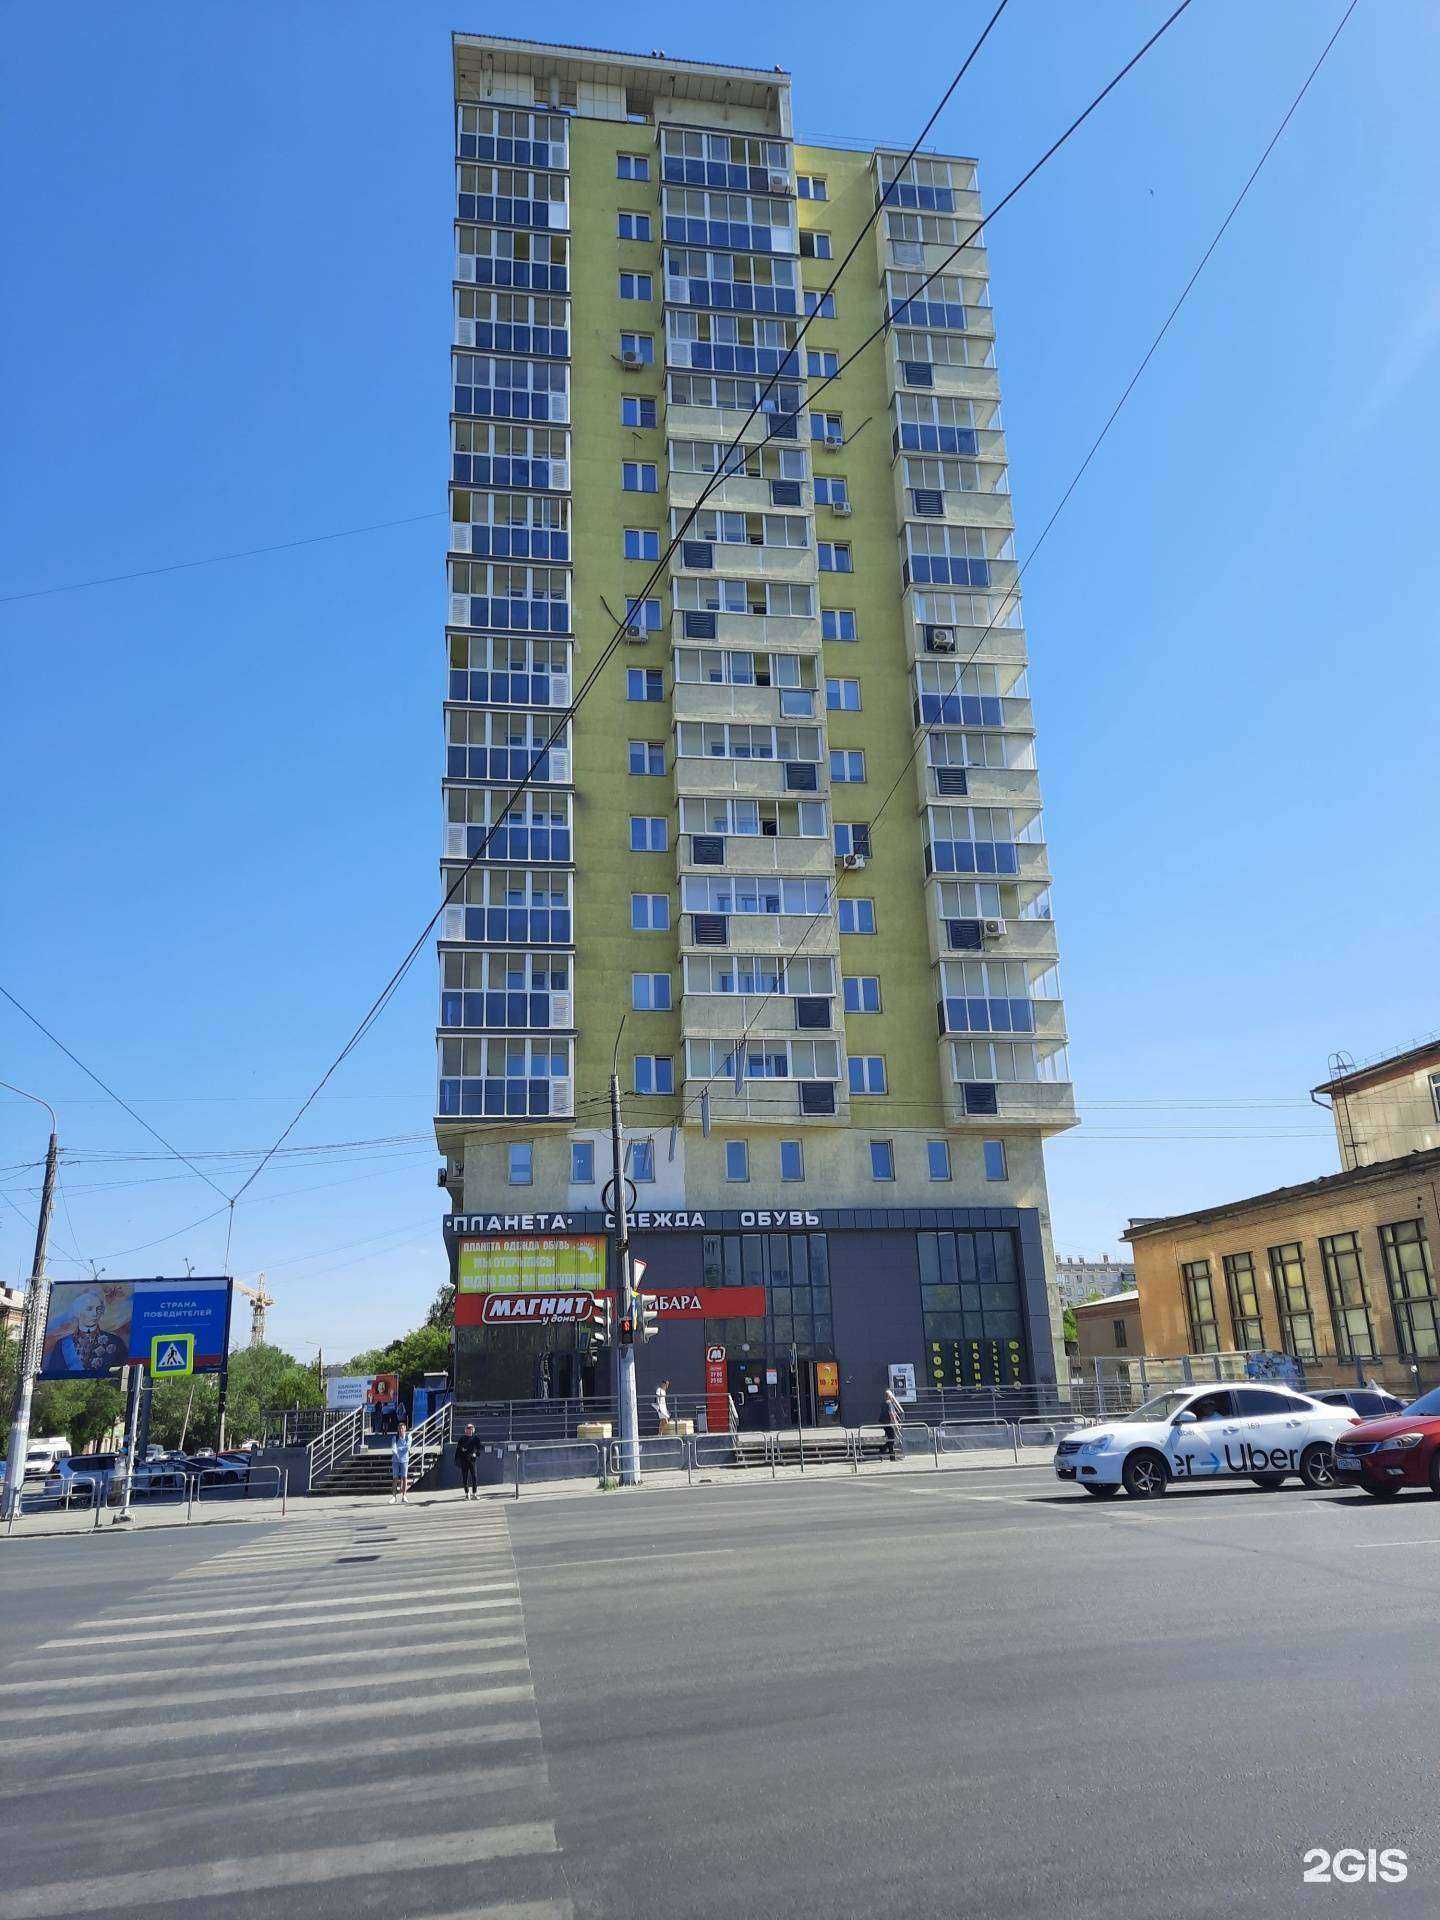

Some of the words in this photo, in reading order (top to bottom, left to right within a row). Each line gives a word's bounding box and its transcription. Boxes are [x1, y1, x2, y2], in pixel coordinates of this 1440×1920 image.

[453, 1214, 567, 1232] ПЛАНЕТА
[740, 1211, 820, 1227] ОБУВЬ
[463, 1241, 501, 1252] ПЛАНЕТА
[503, 1240, 540, 1251] ОДЕЖДА
[543, 1240, 570, 1250] ОБУВЬ
[160, 1301, 197, 1309] СТРАНА
[489, 1297, 588, 1317] МАГНИТ
[143, 1309, 212, 1318] ПОБЕДИТЕЛЕЙ
[542, 1316, 550, 1326] у
[551, 1314, 576, 1323] дома
[1224, 1444, 1299, 1472] Uber
